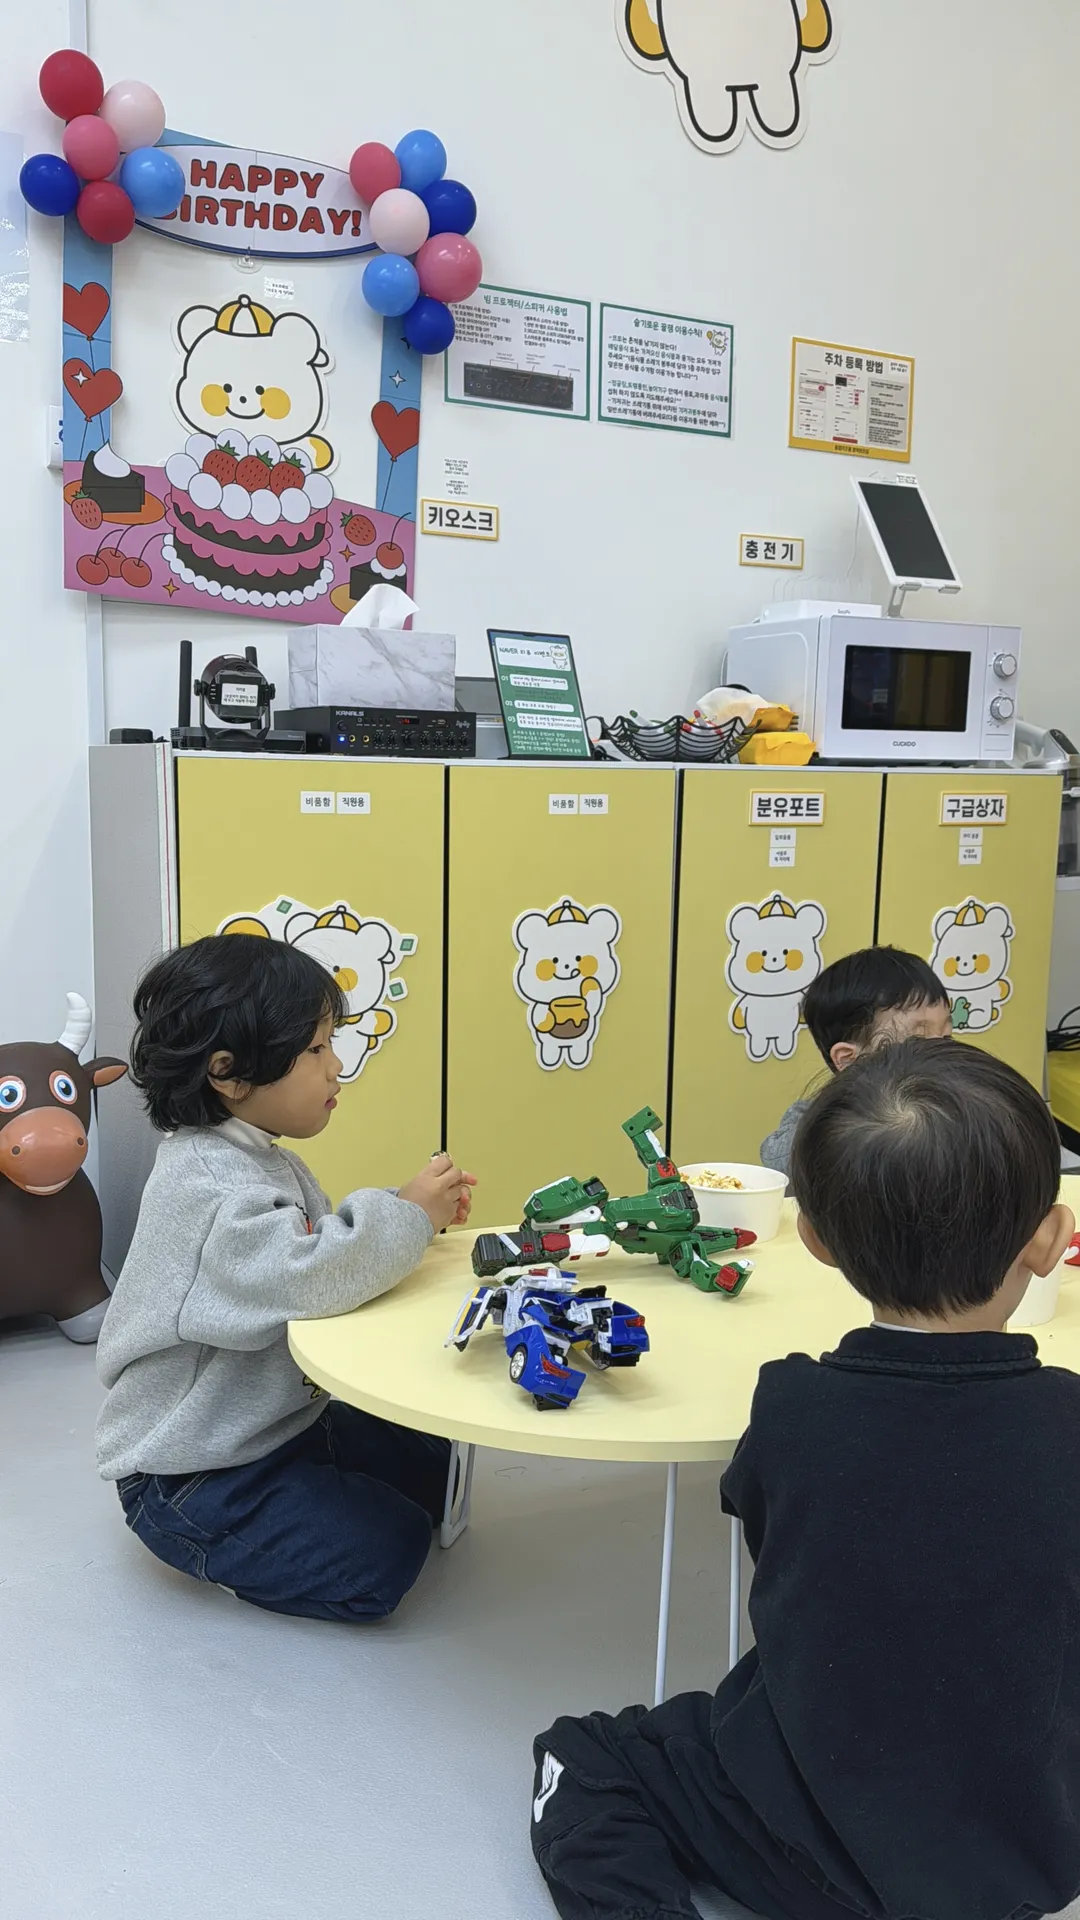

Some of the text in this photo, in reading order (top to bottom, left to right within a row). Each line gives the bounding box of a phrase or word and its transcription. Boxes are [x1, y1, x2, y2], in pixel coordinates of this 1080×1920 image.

[190, 158, 325, 199] HAPPY
[153, 193, 362, 237] IRTHDAY!
[484, 294, 567, 316] 빔 프로젝터/스피커 사용법
[633, 318, 659, 331] 슬기로운
[629, 346, 640, 354] 또는
[641, 347, 660, 357] 가져오신
[644, 339, 658, 348] 남기지
[824, 352, 842, 367] 주차
[845, 355, 863, 370] 등록
[865, 359, 883, 374] 방법
[428, 506, 493, 531] 키오스크
[745, 540, 794, 562] 충전기
[305, 797, 331, 807] 비품함
[342, 797, 365, 807] 직원용
[552, 799, 574, 808] 비품함
[584, 798, 603, 808] 직원용
[757, 797, 820, 817] 분유포트
[947, 798, 1004, 818] 구급상자
